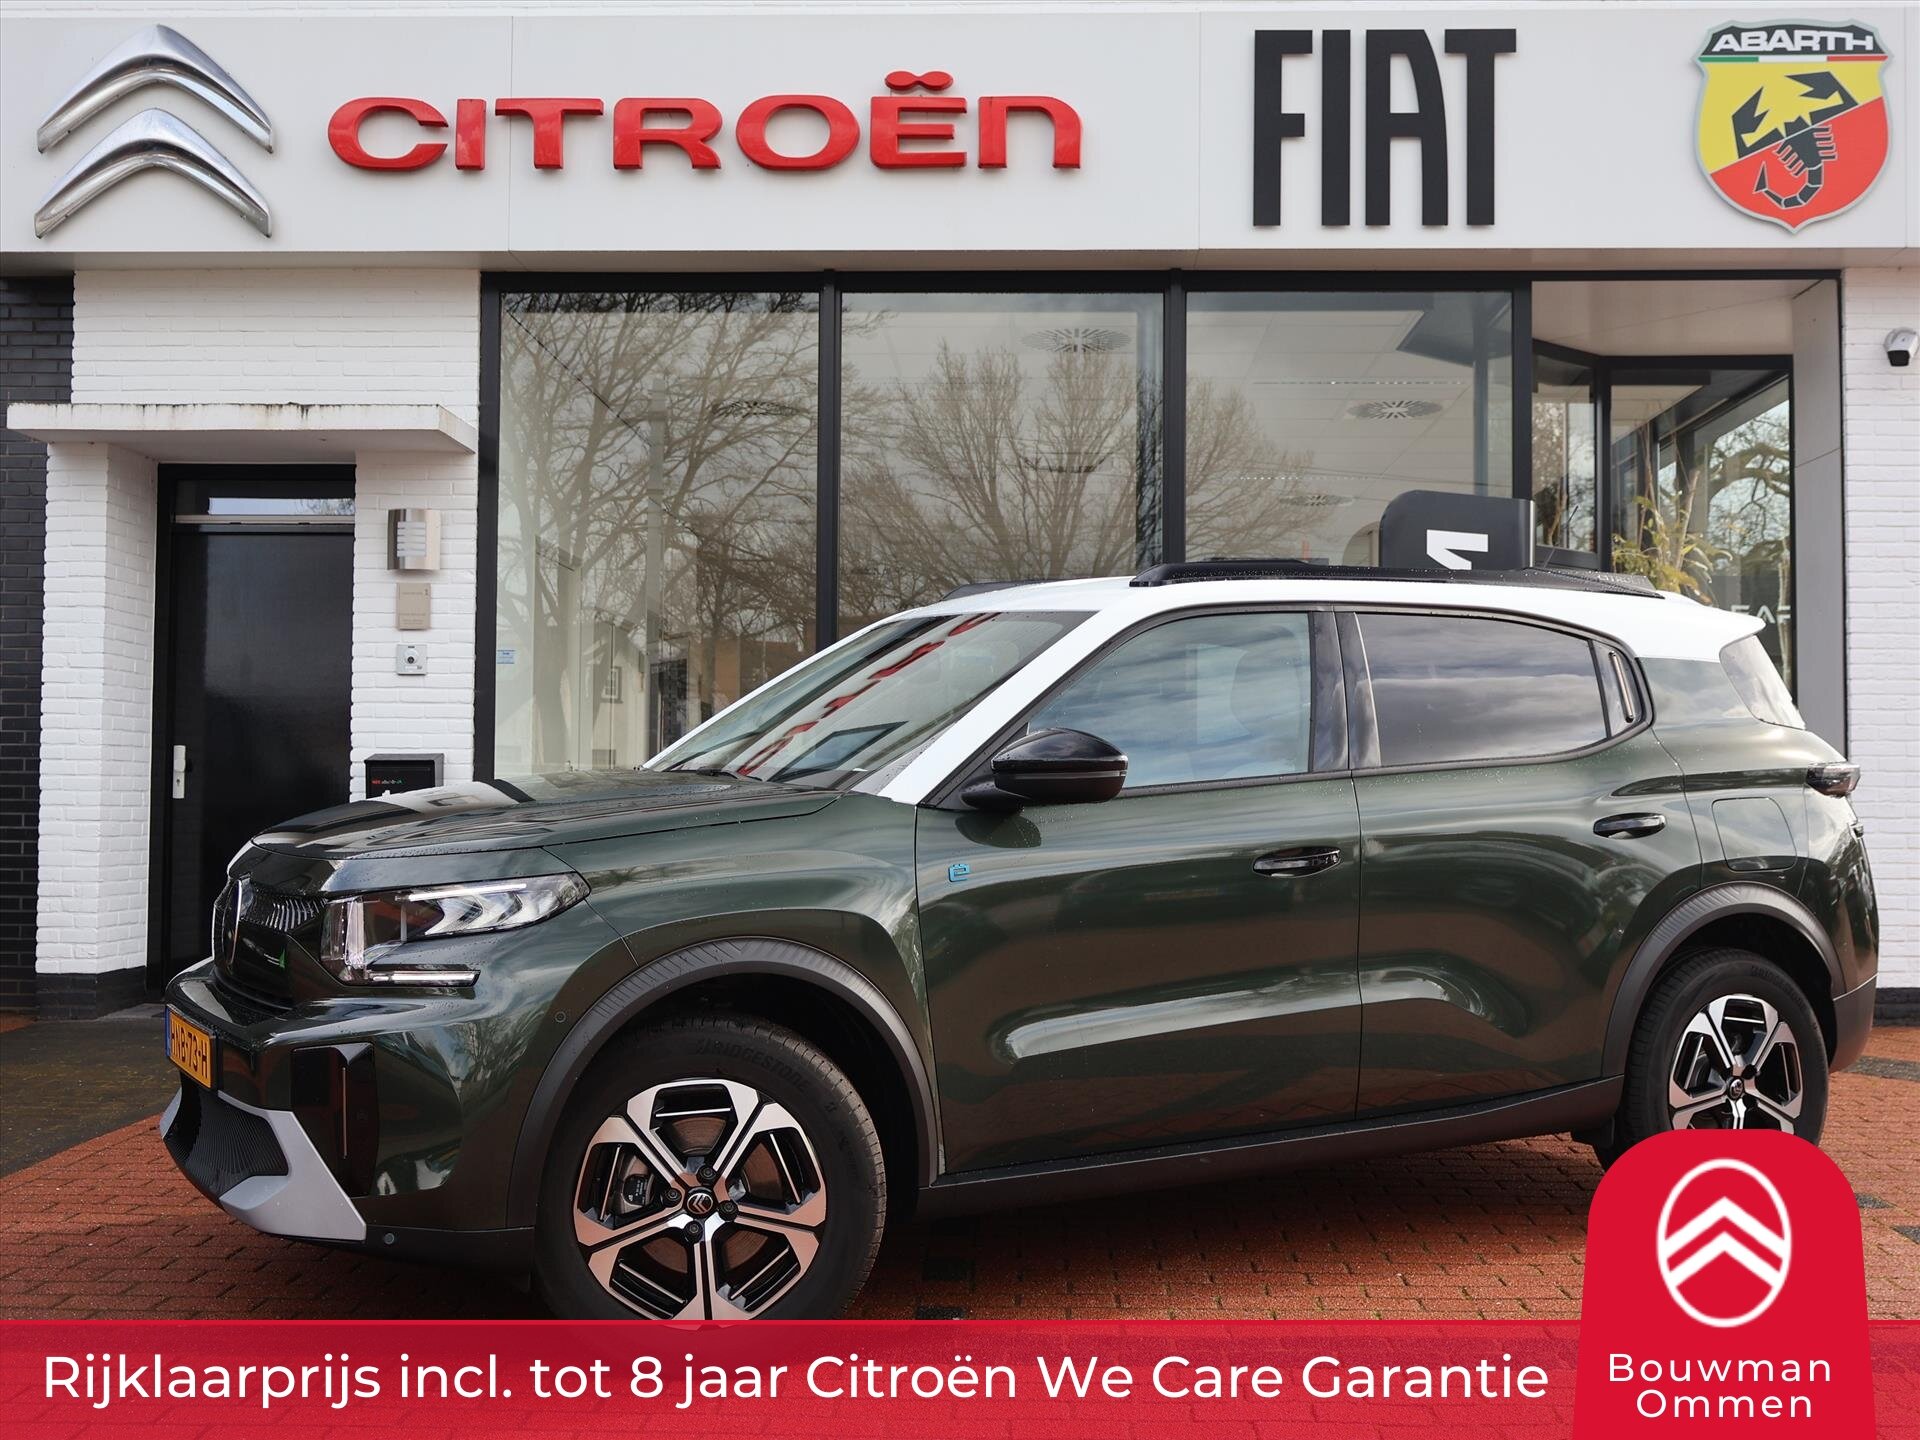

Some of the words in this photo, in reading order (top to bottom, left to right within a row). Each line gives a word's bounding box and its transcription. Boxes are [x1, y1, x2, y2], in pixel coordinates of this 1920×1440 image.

[1711, 29, 1874, 52] ABARTH
[328, 70, 1083, 171] CITROËN
[1253, 28, 1517, 227] FIAT
[696, 1037, 811, 1093] BRIDGESTONE
